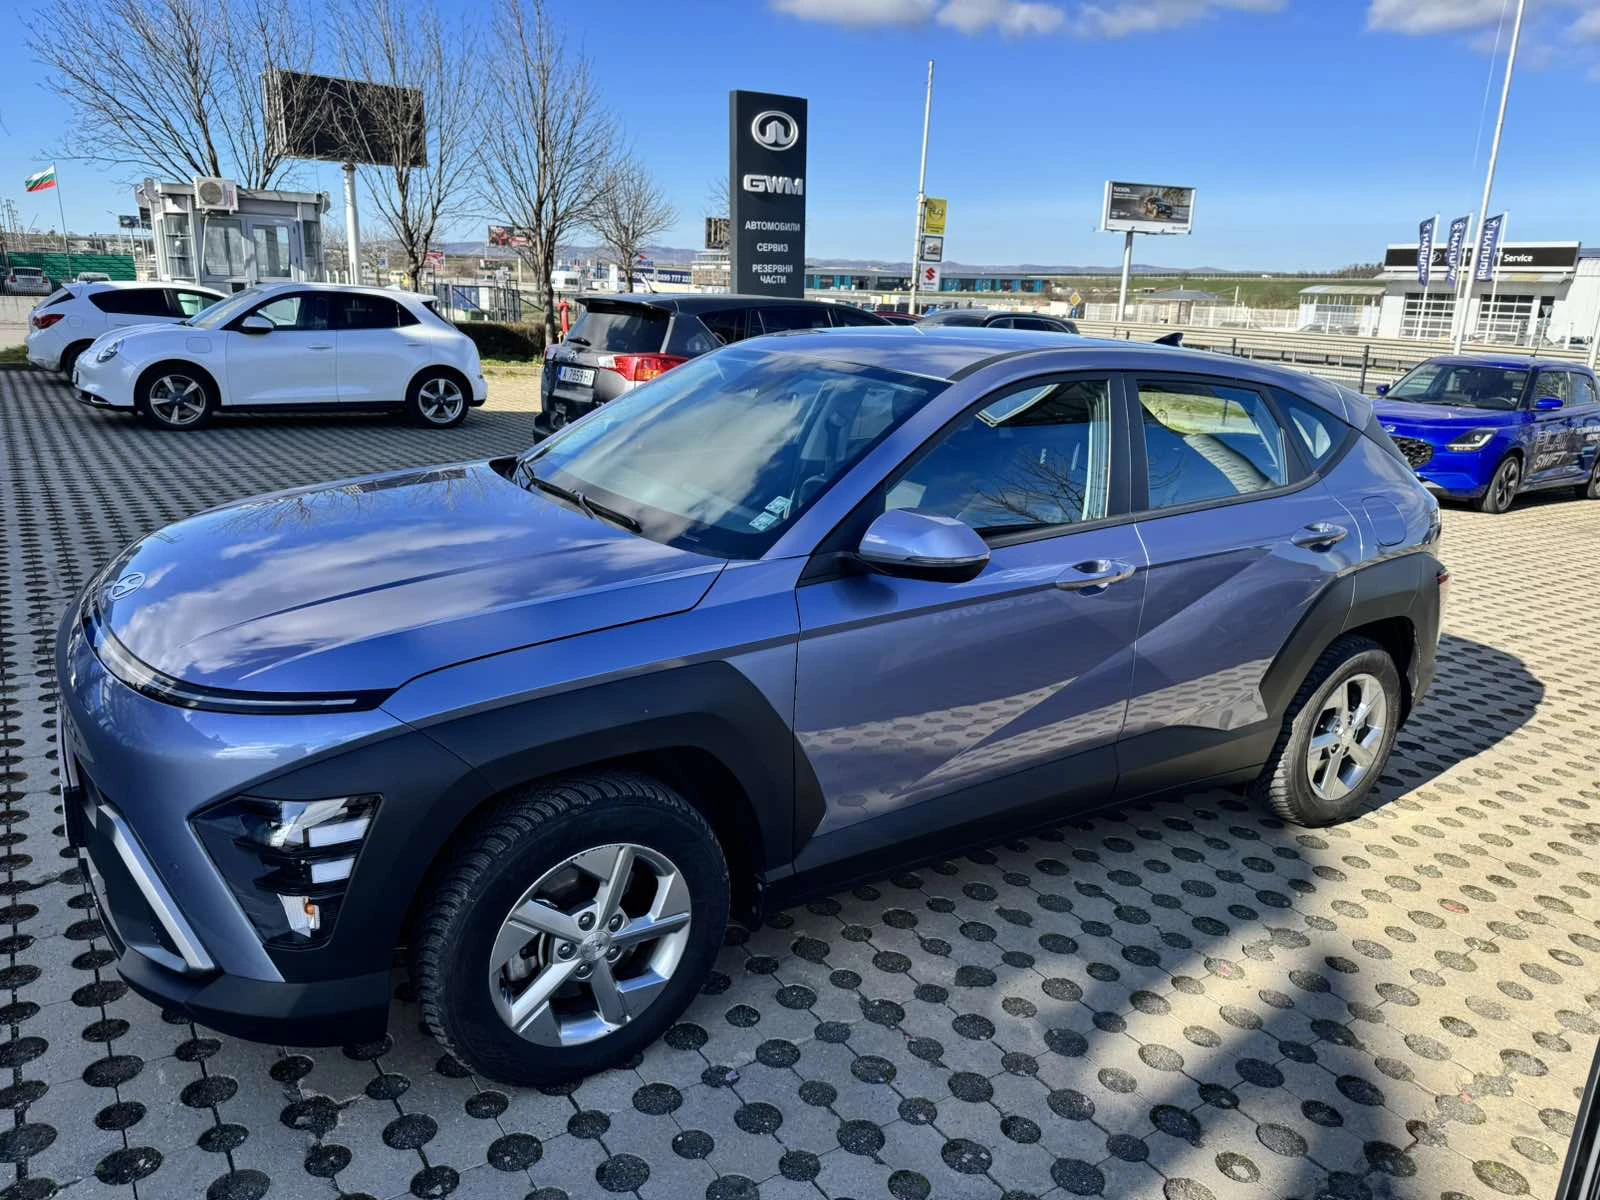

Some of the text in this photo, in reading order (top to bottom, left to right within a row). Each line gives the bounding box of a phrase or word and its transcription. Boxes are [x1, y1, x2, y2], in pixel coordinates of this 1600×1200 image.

[743, 174, 803, 195] GWM
[745, 220, 800, 232] АВТОМОБИЛИ
[756, 242, 789, 252] СЕРВИЗ
[1503, 253, 1534, 262] Service
[752, 264, 793, 273] РЕЗЕРВНИ
[760, 275, 786, 284] ЧАСТИ
[1533, 451, 1568, 468] SWIFT
